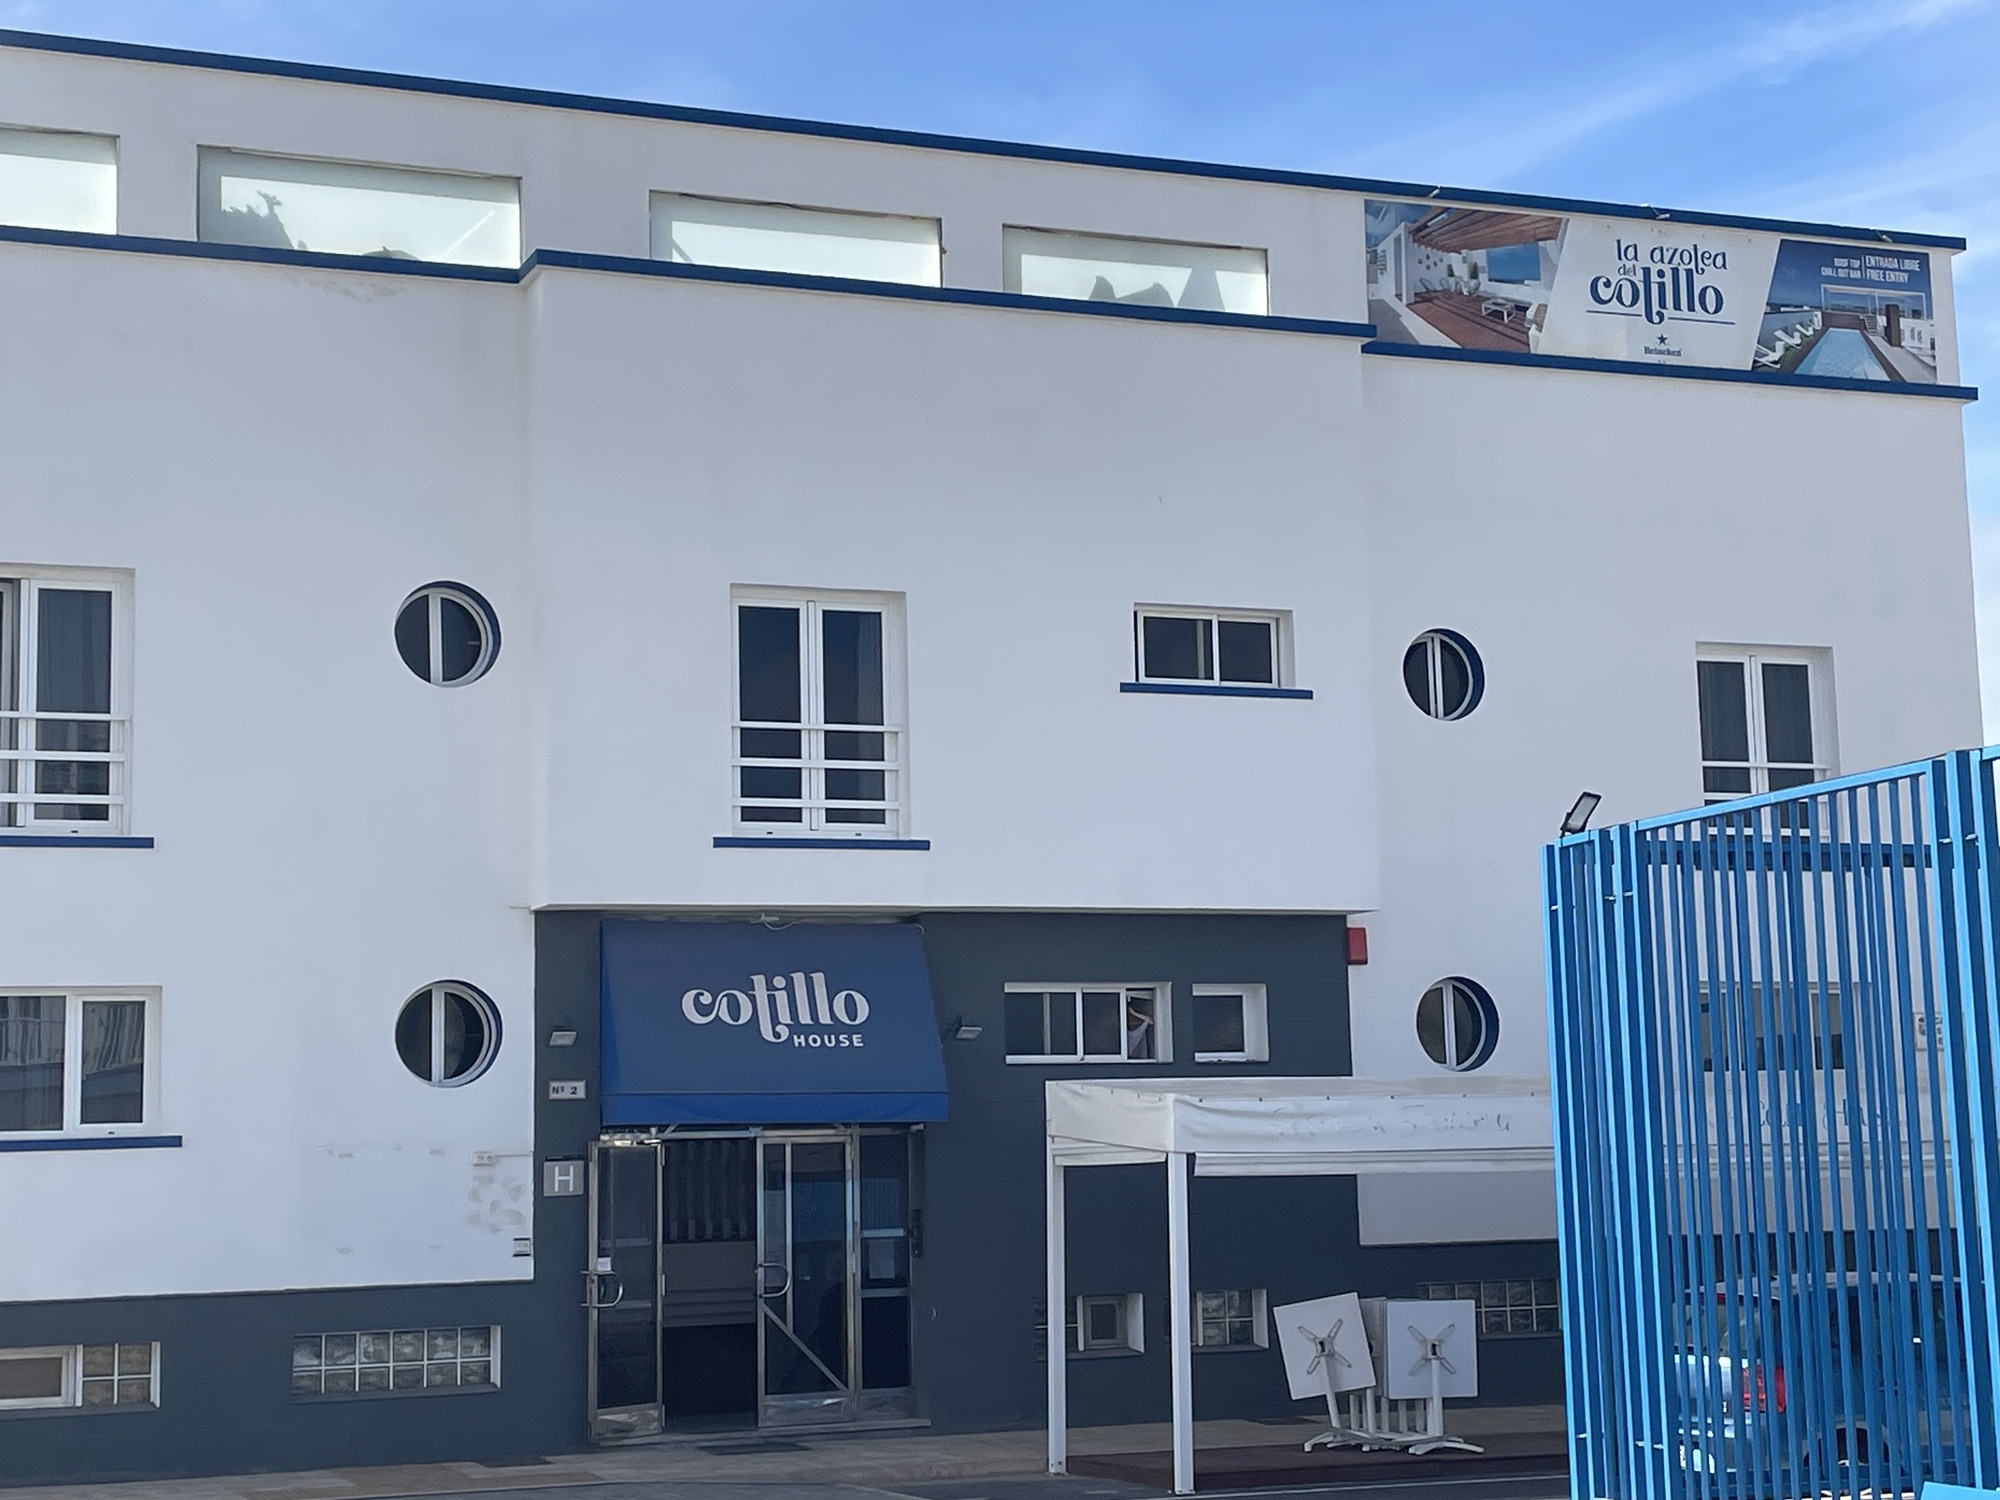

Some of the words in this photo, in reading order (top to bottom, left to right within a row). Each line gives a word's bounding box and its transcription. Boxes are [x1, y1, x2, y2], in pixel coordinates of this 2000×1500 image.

[1616, 238, 1639, 262] la
[1650, 244, 1728, 275] azotea
[1865, 255, 1899, 269] ENTRADA
[1900, 258, 1921, 271] LIBRE
[1617, 263, 1637, 277] del
[1866, 268, 1885, 281] FREE
[1885, 270, 1909, 283] ENTRY
[1590, 266, 1725, 325] cotillo
[681, 971, 870, 1043] cotillo
[792, 1033, 865, 1048] HOUSE
[570, 1086, 578, 1095] 2
[554, 1165, 574, 1192] H
